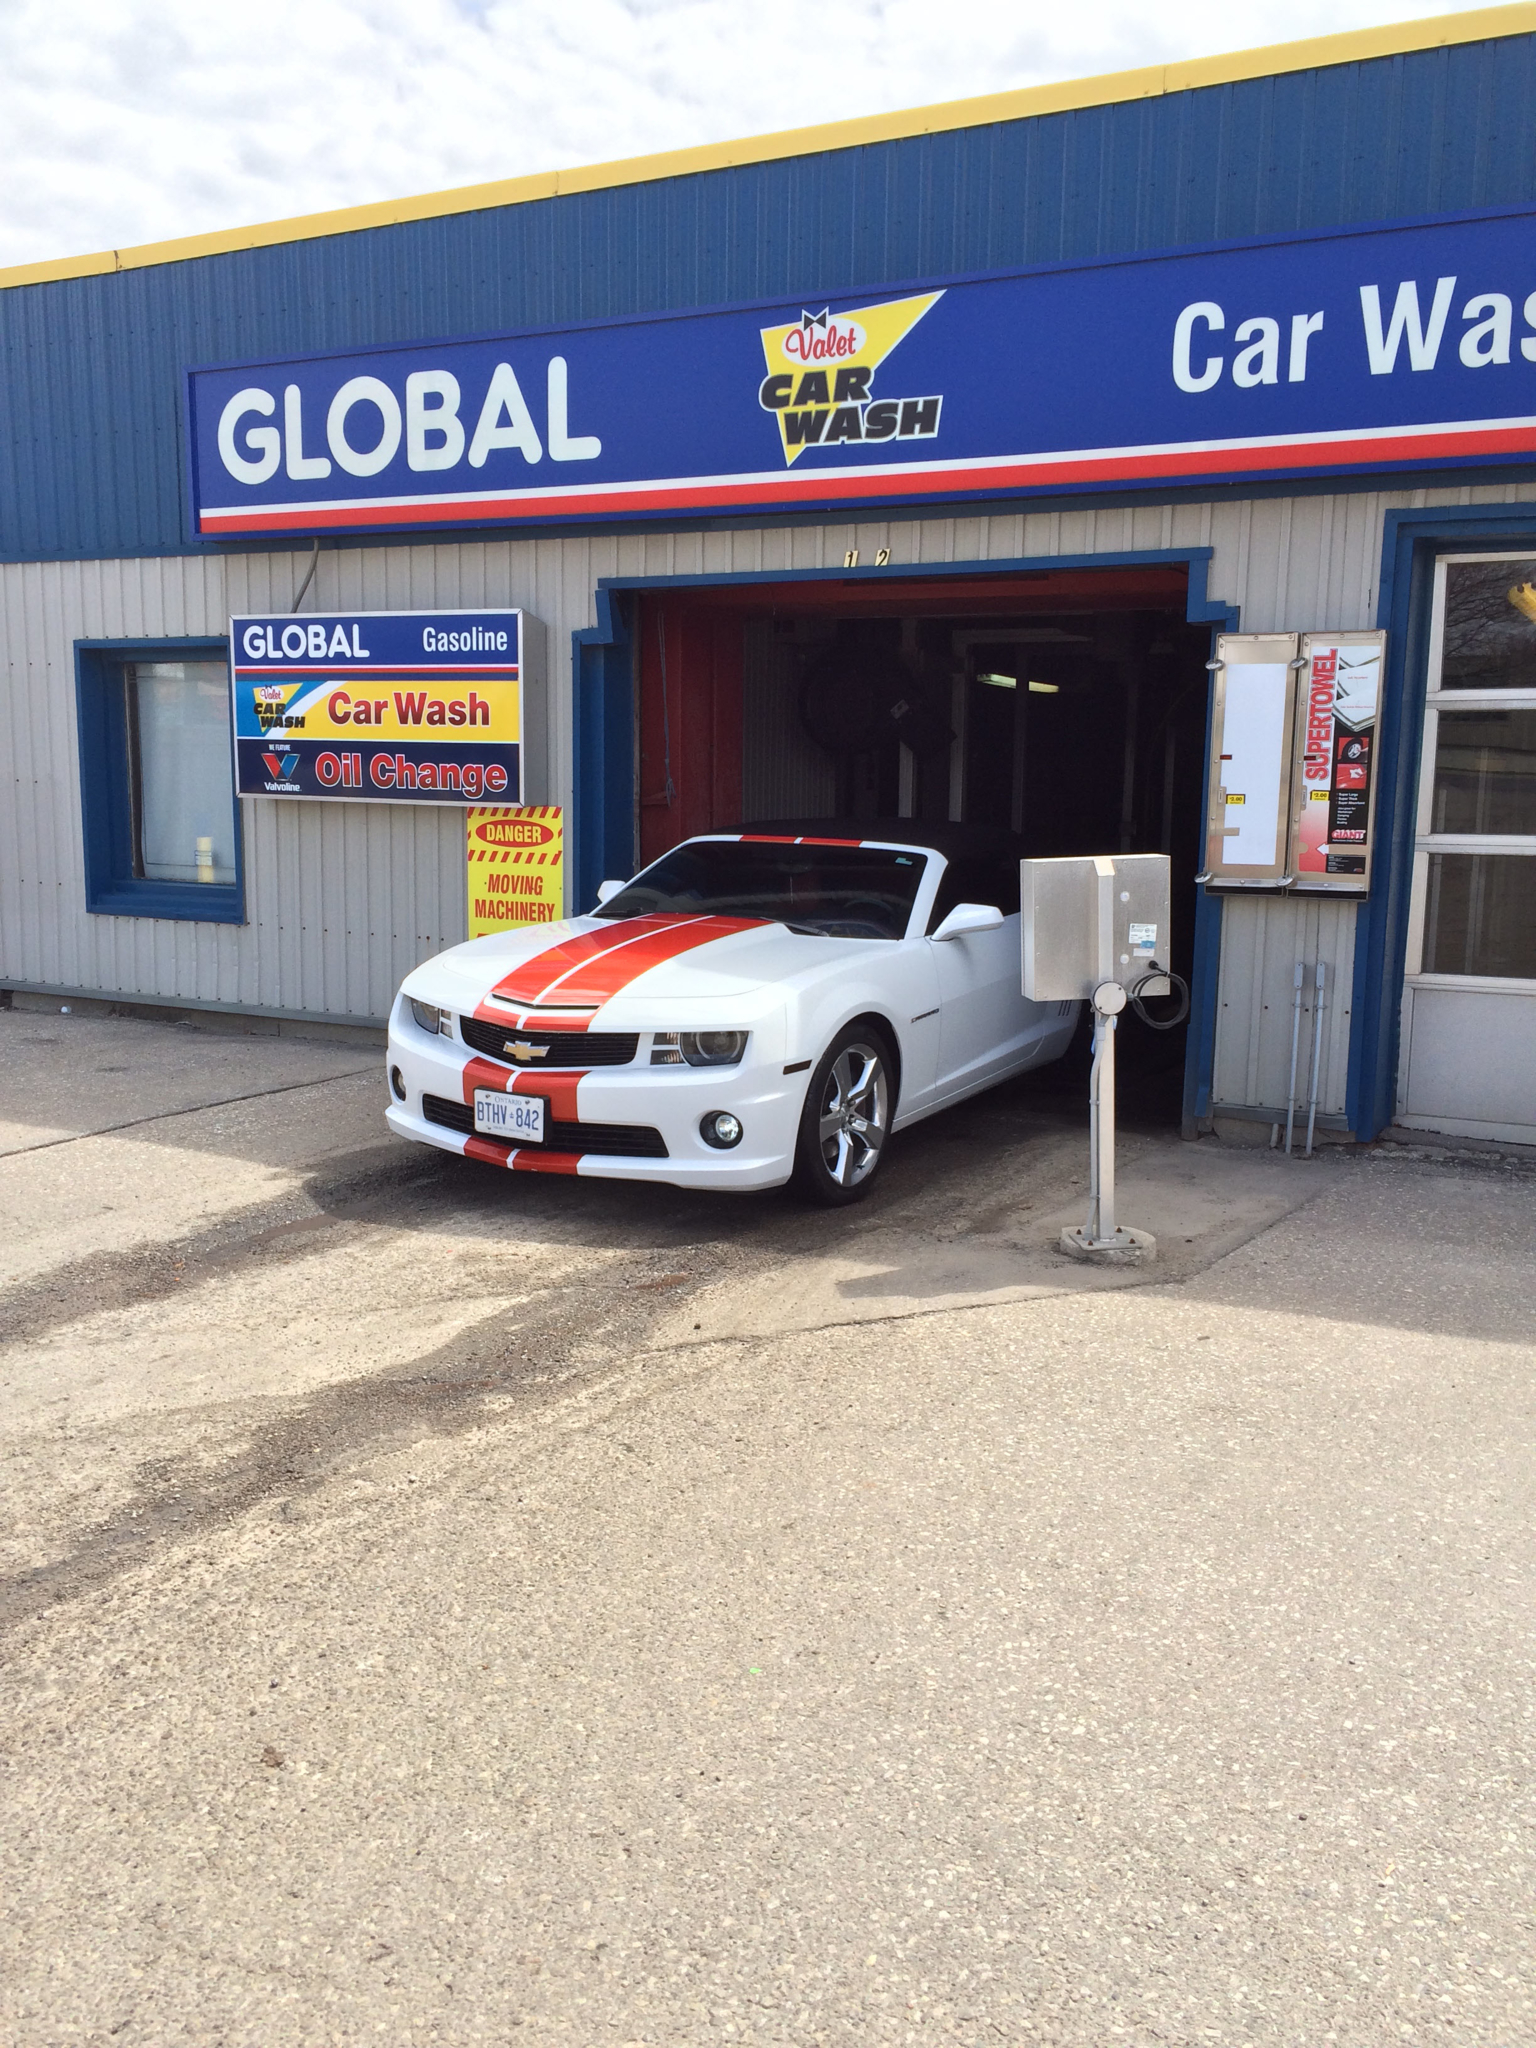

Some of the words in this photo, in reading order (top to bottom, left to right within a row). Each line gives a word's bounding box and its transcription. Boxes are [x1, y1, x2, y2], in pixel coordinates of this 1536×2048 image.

[785, 325, 856, 361] Valet
[1172, 301, 1324, 393] Car
[761, 366, 870, 410] CAR
[217, 355, 602, 485] GLOBAL
[784, 397, 942, 446] WASH
[242, 623, 371, 659] GLOBAL
[422, 626, 508, 652] Gasoline
[253, 703, 286, 715] CAR
[259, 688, 282, 700] Valet
[327, 690, 389, 726] Car
[393, 691, 491, 727] Wash
[260, 716, 306, 728] WASH
[1305, 648, 1338, 781] SUPERTOWEL
[264, 782, 301, 792] Valvoline
[315, 752, 363, 788] Oil
[370, 752, 508, 799] Change
[486, 824, 542, 843] DANGER
[1331, 829, 1366, 839] GIANT
[487, 873, 543, 895] MOVING
[475, 898, 556, 922] MACHINERY
